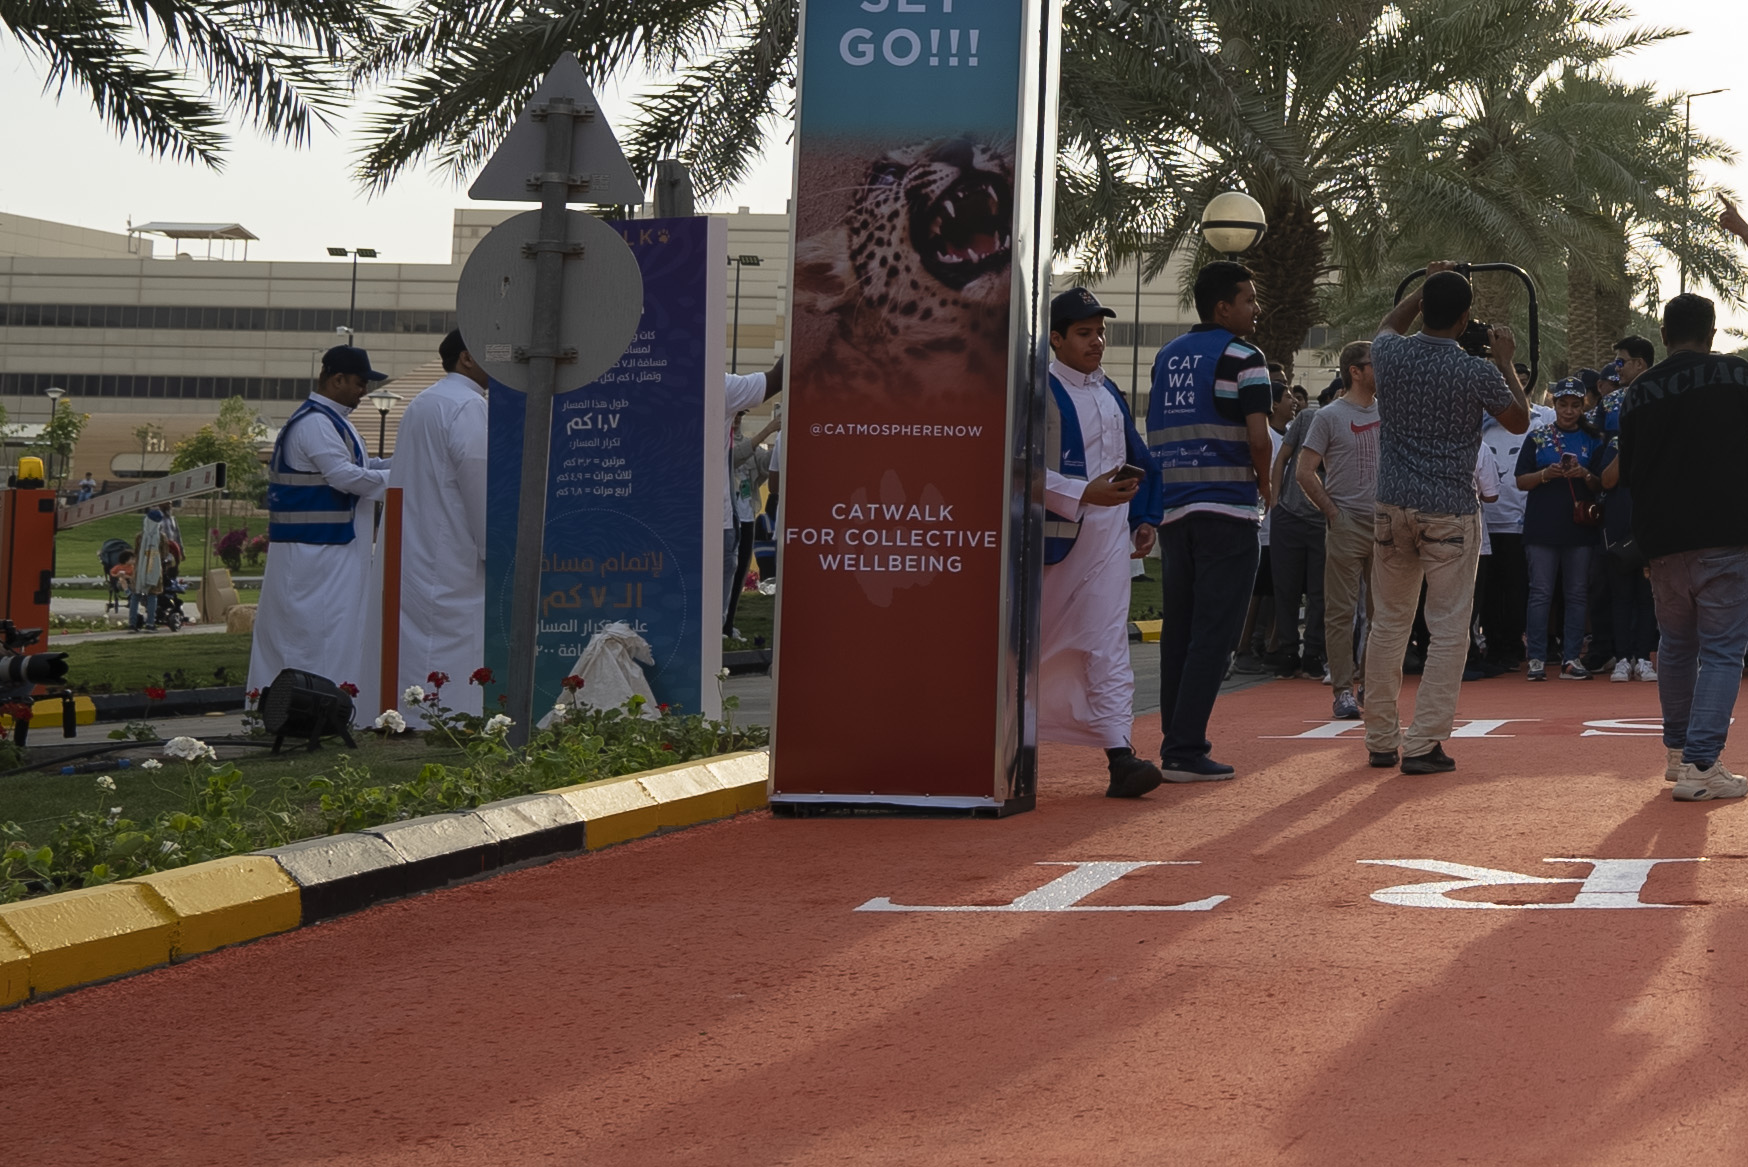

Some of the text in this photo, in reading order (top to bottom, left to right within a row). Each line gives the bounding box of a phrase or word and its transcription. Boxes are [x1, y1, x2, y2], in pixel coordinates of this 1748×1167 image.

[839, 28, 980, 67] GO!!!
[1168, 354, 1202, 370] CAT
[1168, 372, 1194, 388] WA
[562, 400, 590, 412] المسار
[1164, 390, 1186, 406] LK
[566, 412, 593, 435] كم
[810, 424, 983, 438] @CATMOSPHERENOW
[831, 504, 954, 522] CATWALK
[786, 528, 997, 548] FOR COLLECTIVE
[600, 552, 664, 578] لإتمام
[819, 554, 962, 573] WELLBEING
[541, 583, 582, 617] كم
